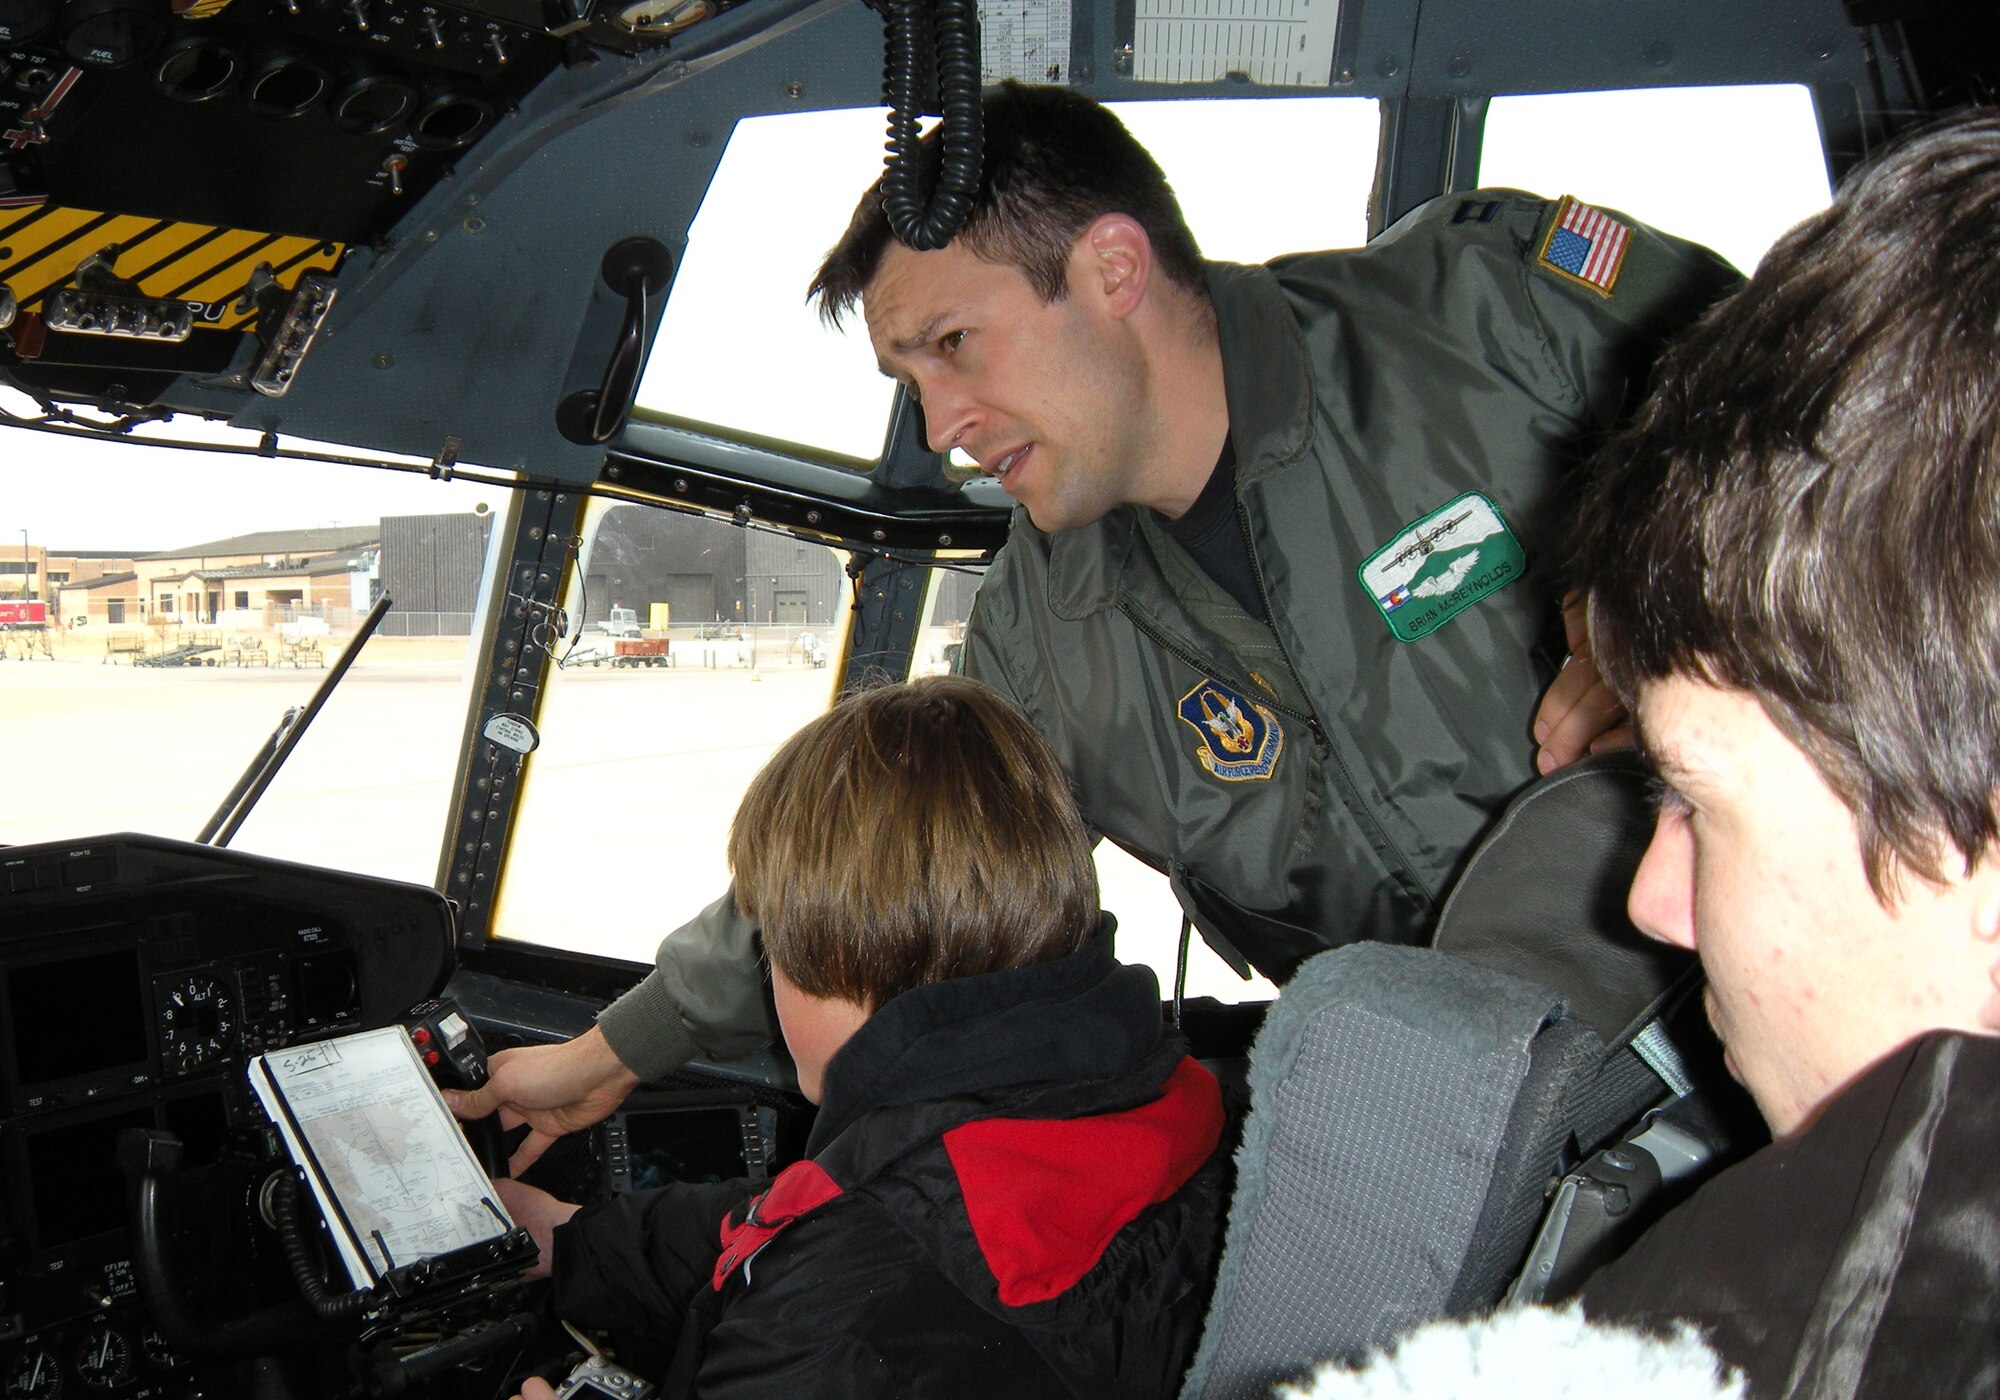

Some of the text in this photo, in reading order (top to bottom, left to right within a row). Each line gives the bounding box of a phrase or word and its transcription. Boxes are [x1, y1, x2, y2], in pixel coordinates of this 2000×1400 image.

[90, 49, 113, 59] FUEL
[30, 55, 47, 64] TST
[1408, 609, 1438, 632] BRIAN
[189, 984, 197, 995] 0
[193, 992, 206, 1001] ALT
[217, 998, 224, 1008] 2
[166, 1009, 173, 1020] 8
[220, 1021, 227, 1031] 3
[180, 1042, 187, 1052] 6
[196, 1044, 202, 1054] 5
[29, 1097, 42, 1107] TEST
[49, 1260, 64, 1271] TEST
[115, 1282, 129, 1292] OFF
